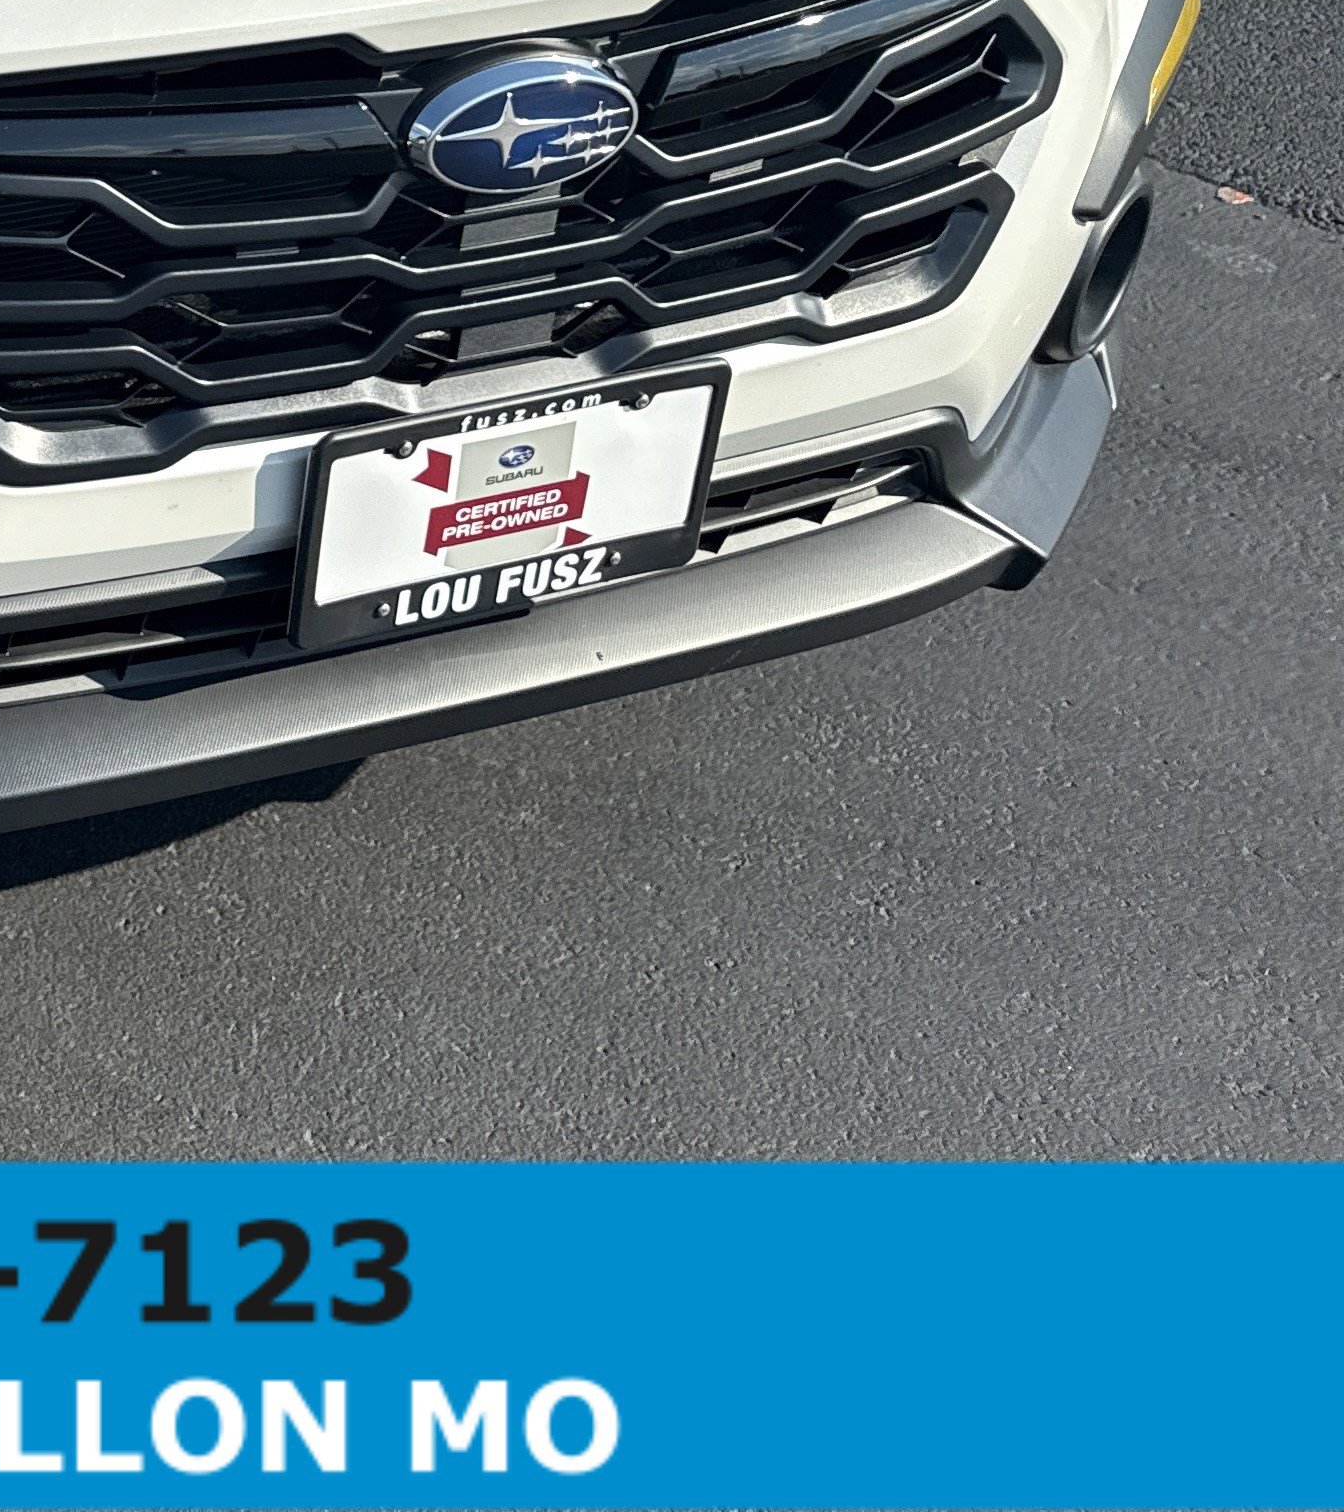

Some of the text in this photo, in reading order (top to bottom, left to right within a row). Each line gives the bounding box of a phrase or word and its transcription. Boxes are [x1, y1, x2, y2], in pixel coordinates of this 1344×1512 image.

[460, 392, 603, 434] fusz.com
[485, 465, 545, 486] SUBARU
[441, 503, 569, 543] PRE-OWNED
[455, 488, 562, 523] CERTIFIED
[394, 546, 608, 627] LOU FUSZ
